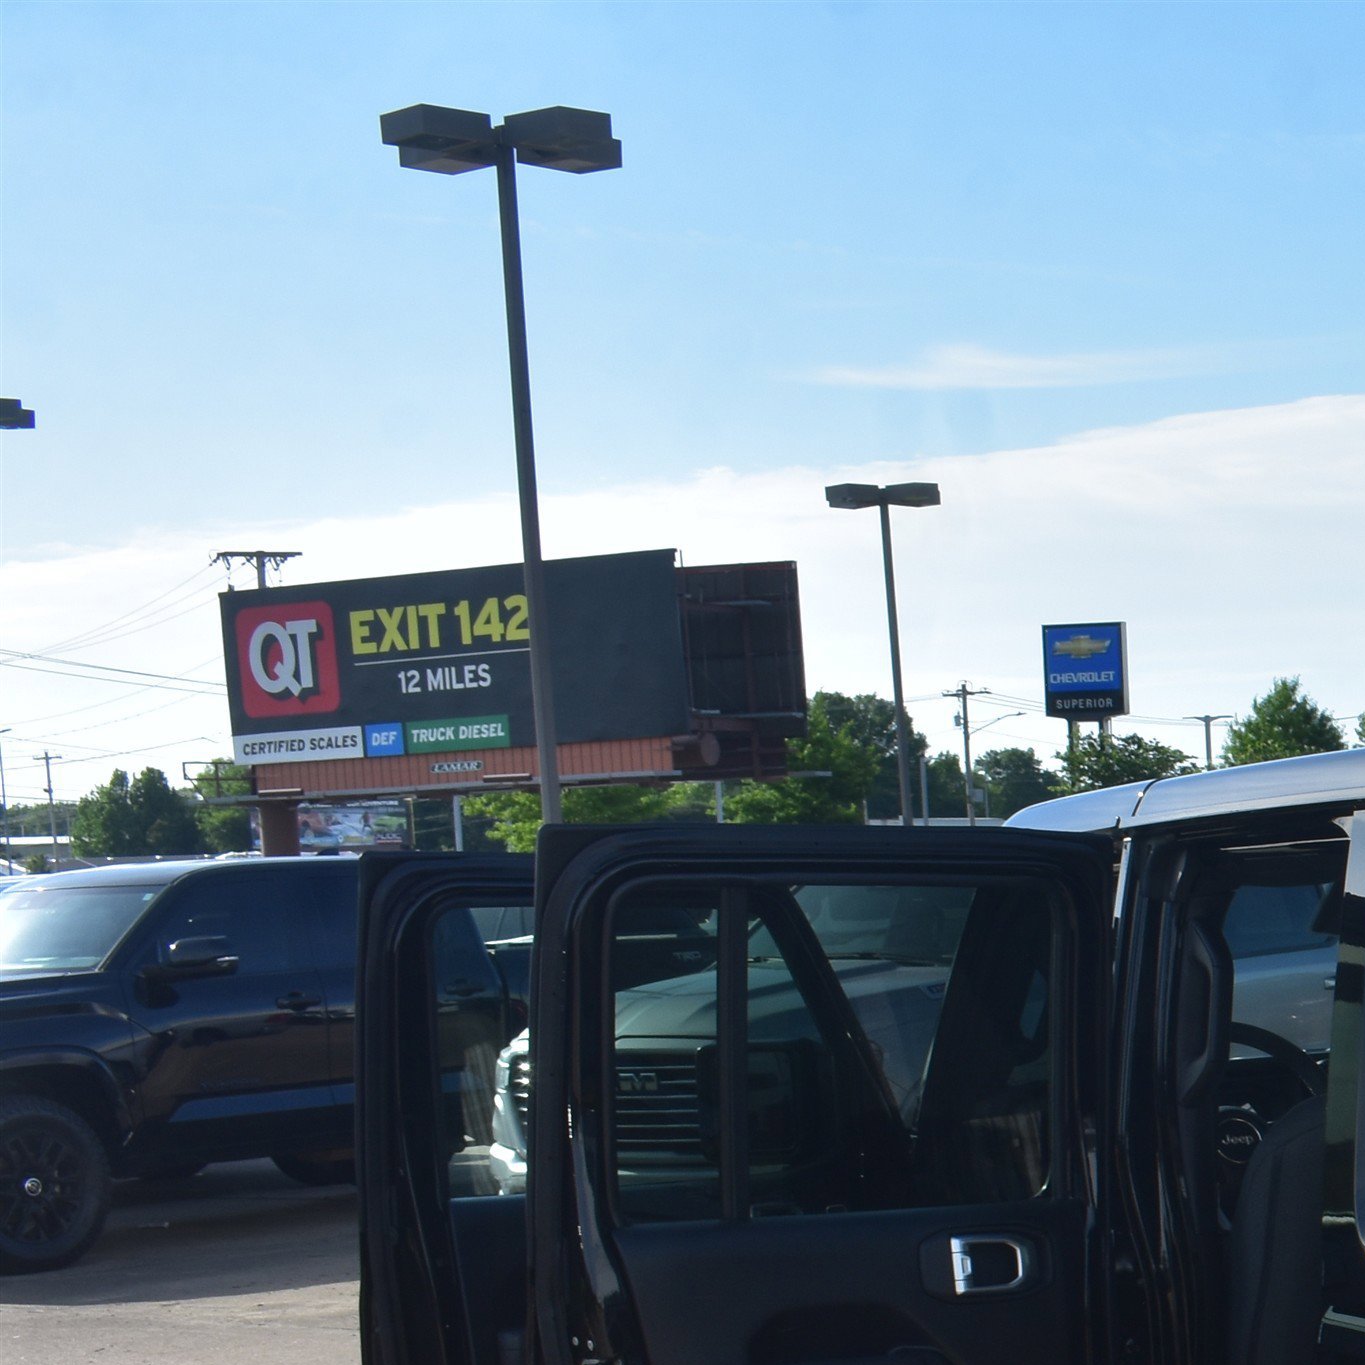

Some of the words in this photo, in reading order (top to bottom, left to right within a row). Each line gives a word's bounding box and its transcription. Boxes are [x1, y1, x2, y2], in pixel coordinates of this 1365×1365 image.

[350, 602, 446, 655] EXIT
[454, 594, 531, 646] 142
[249, 619, 317, 697] QT
[398, 670, 421, 694] 12
[427, 663, 491, 692] MILES
[1050, 671, 1115, 684] CHEVROLET
[1056, 698, 1113, 709] SUPERIOR
[372, 731, 397, 746] DEF
[411, 727, 454, 743] TRUCK
[459, 723, 505, 739] DIESEL
[243, 738, 305, 756] CERTIFIED
[309, 735, 358, 751] SCALES
[433, 761, 479, 772] LAMAR
